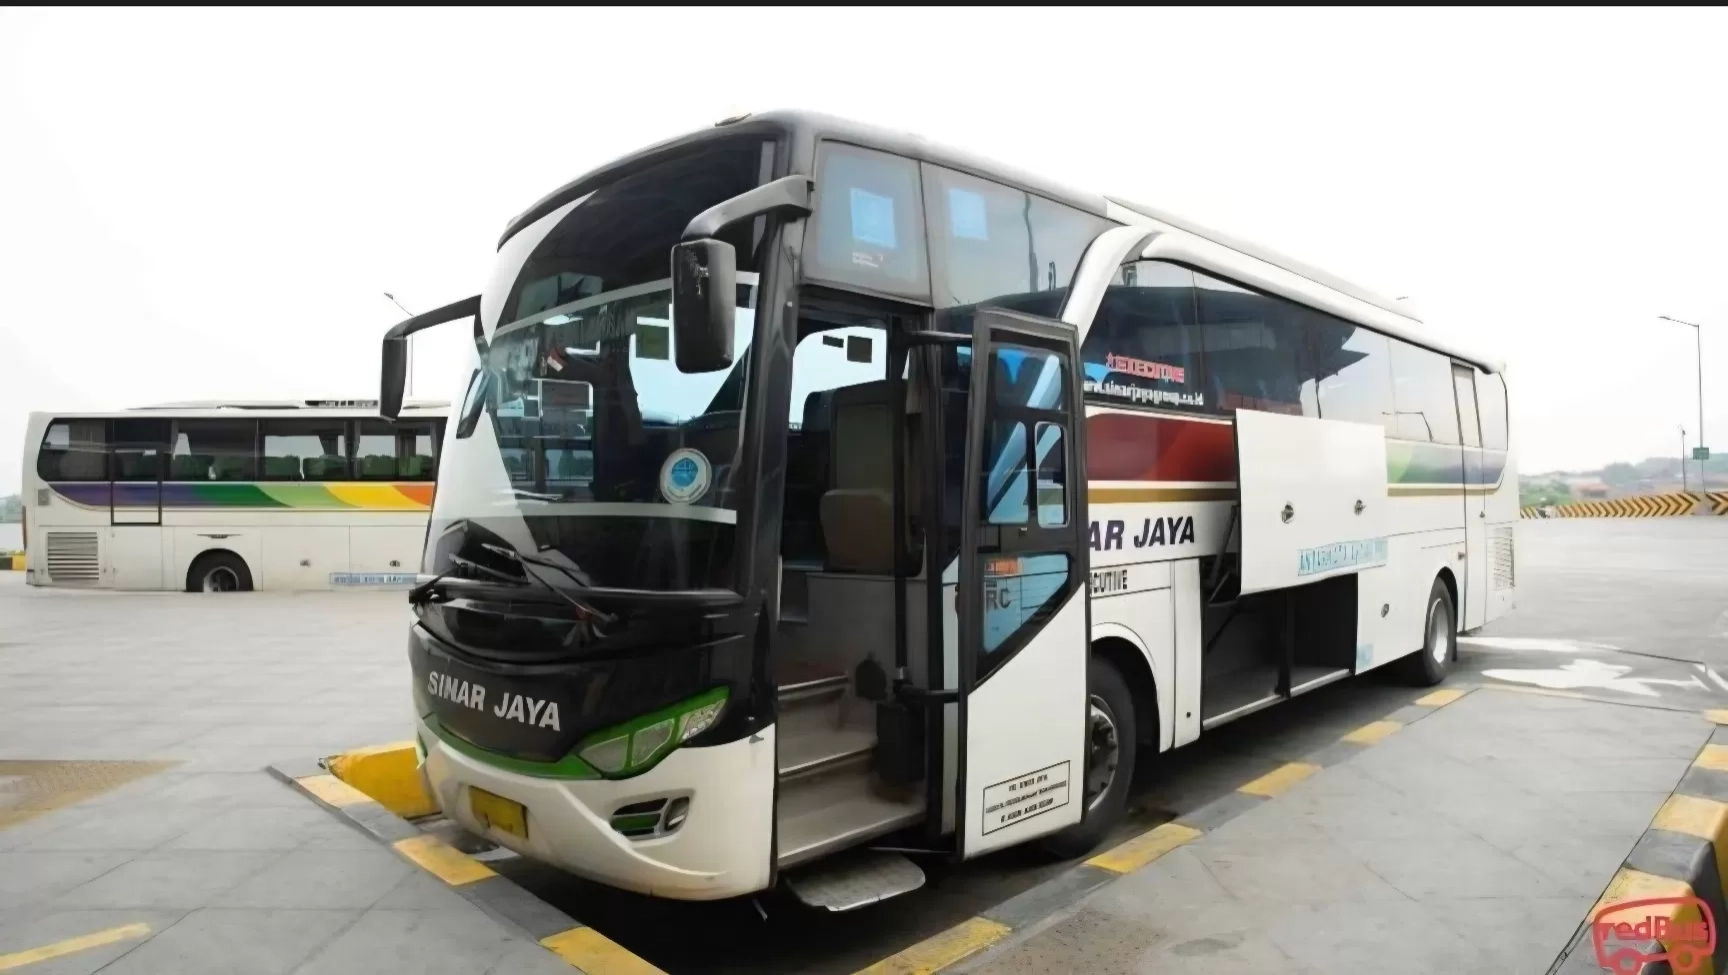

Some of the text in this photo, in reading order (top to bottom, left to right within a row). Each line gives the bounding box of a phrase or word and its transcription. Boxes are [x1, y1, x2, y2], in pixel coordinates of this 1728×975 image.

[1134, 516, 1195, 548] JAYA
[428, 671, 561, 732] SINAR JAYA
